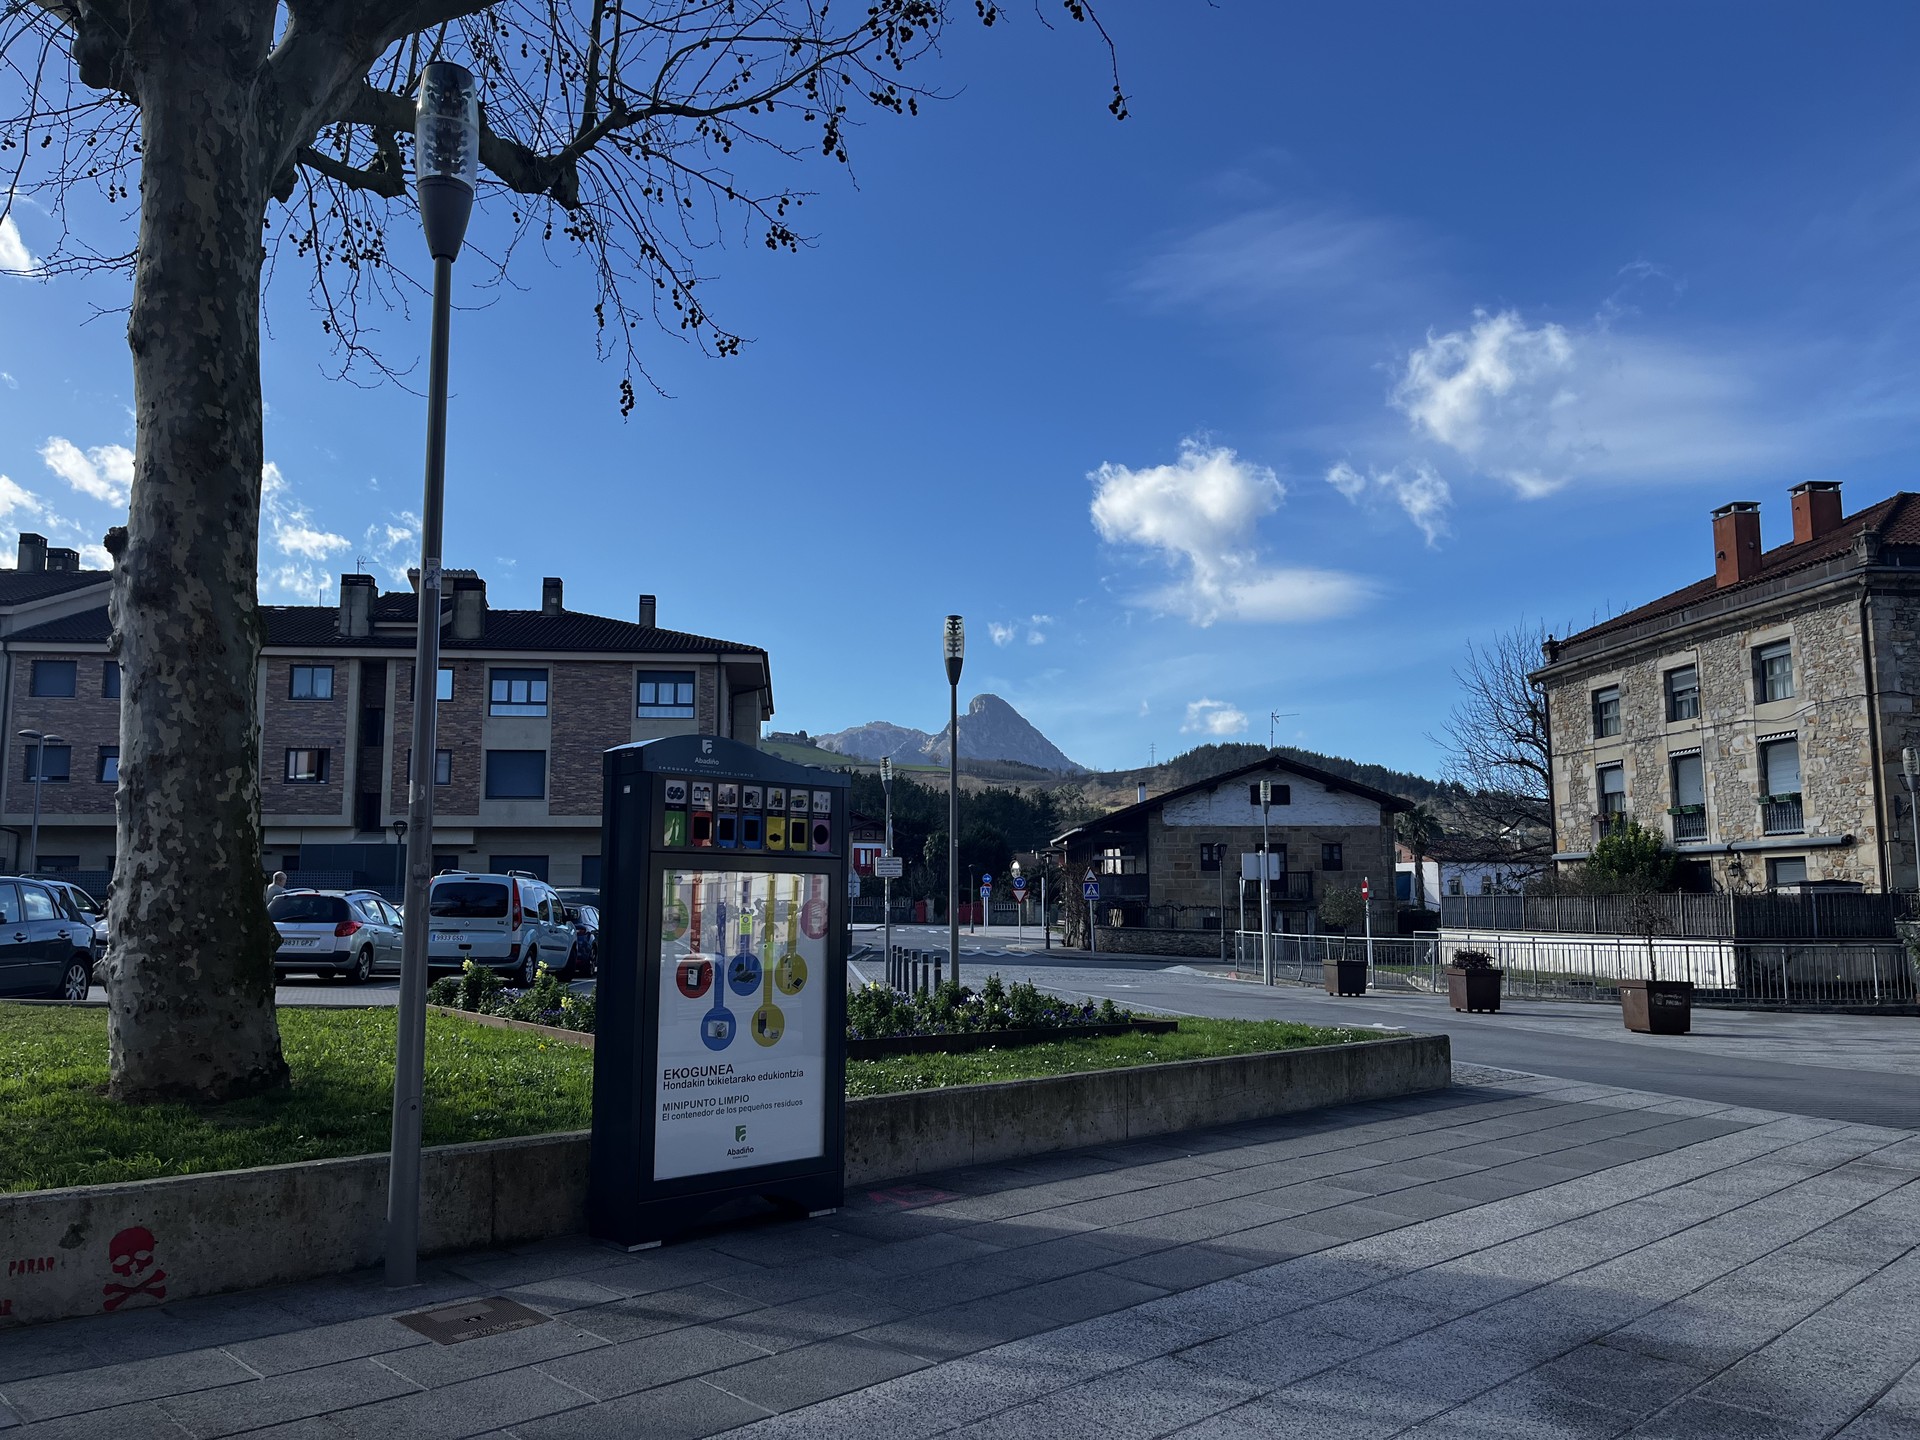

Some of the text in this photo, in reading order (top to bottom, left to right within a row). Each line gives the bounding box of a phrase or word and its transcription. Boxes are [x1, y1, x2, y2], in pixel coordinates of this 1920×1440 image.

[694, 757, 720, 766] Abadiño
[663, 1063, 734, 1080] EKOGUNEA
[663, 1069, 804, 1091] Hondakin txikietarako edukiontzia
[662, 1094, 750, 1112] MINIPUNTO LIMPIO
[662, 1099, 803, 1121] El contenedor de los pequeños residuos
[726, 1145, 755, 1157] Abadiño
